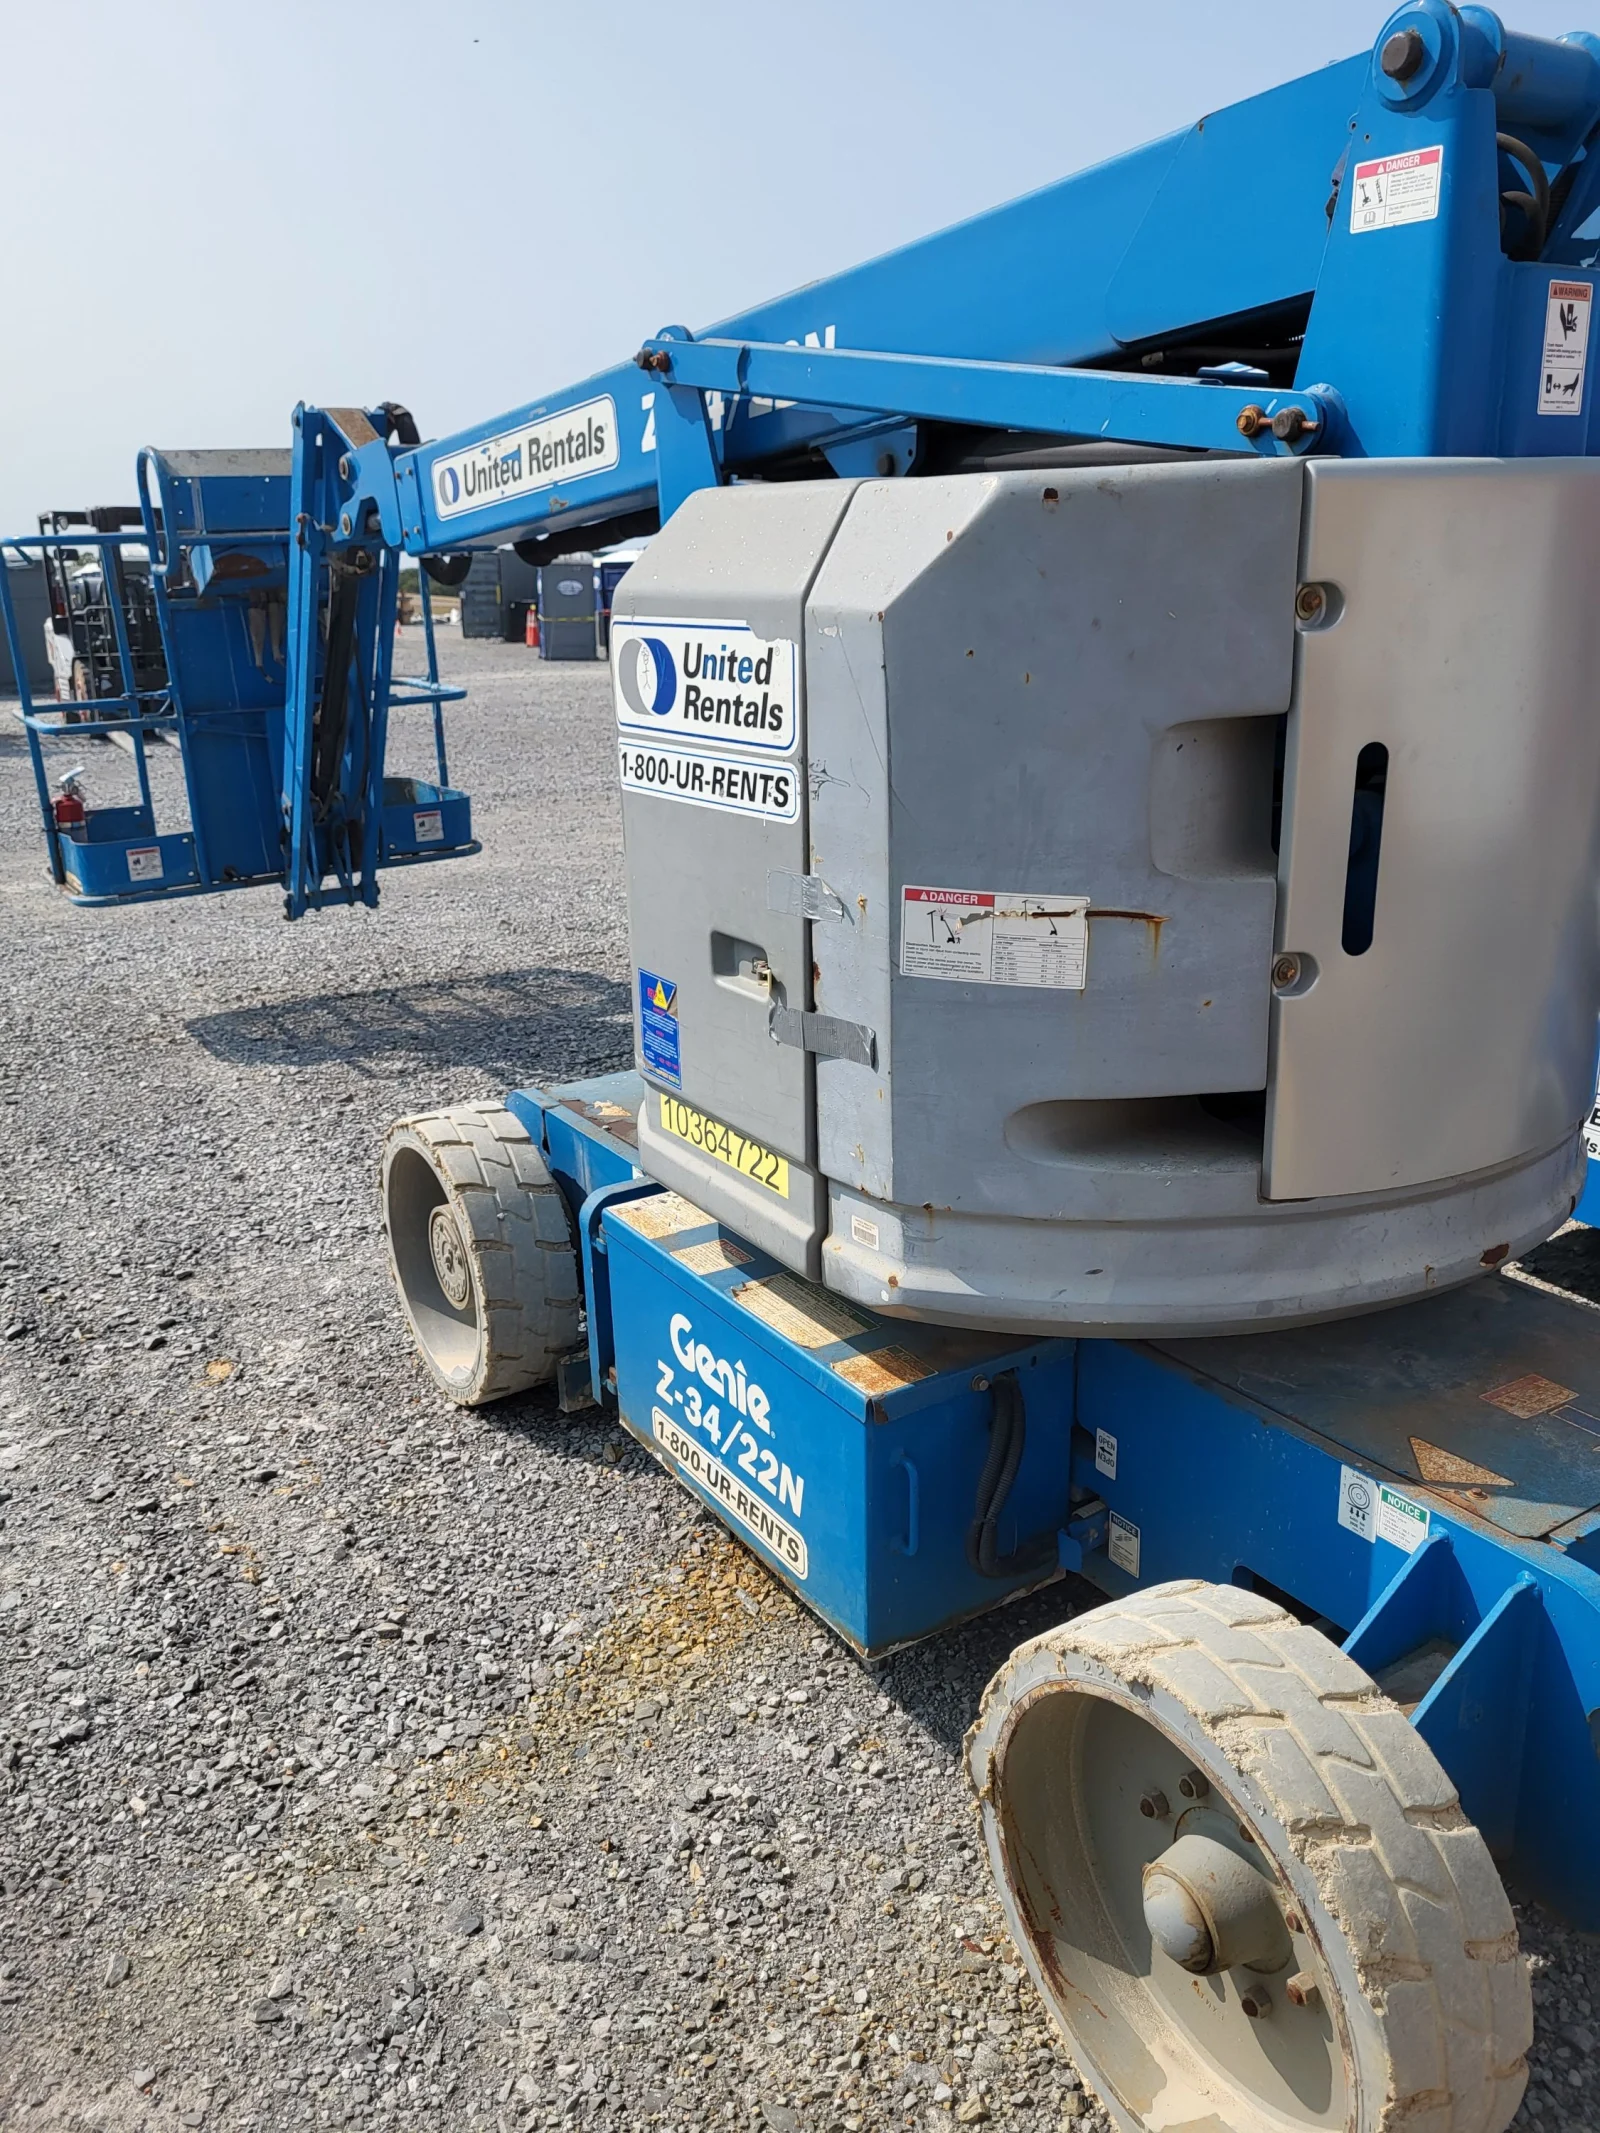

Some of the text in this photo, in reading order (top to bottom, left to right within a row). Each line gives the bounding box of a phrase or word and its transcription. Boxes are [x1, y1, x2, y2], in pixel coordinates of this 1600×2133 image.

[1386, 155, 1420, 172] DANGER
[1558, 287, 1588, 298] WARNING
[463, 416, 605, 497] United Rentals
[683, 641, 774, 685] United
[683, 684, 784, 732] Rentals
[621, 751, 790, 808] 1-800-UR-RENTS
[929, 891, 978, 905] DANGER
[664, 1097, 780, 1191] 10364722
[669, 1312, 771, 1436] Genie
[655, 1358, 805, 1518] Z-34/22N
[1098, 1435, 1115, 1451] OPEN
[657, 1420, 800, 1563] 1-800-UR-RENTS
[1387, 1493, 1421, 1520] NOTICE
[1112, 1515, 1138, 1536] NOTICE
